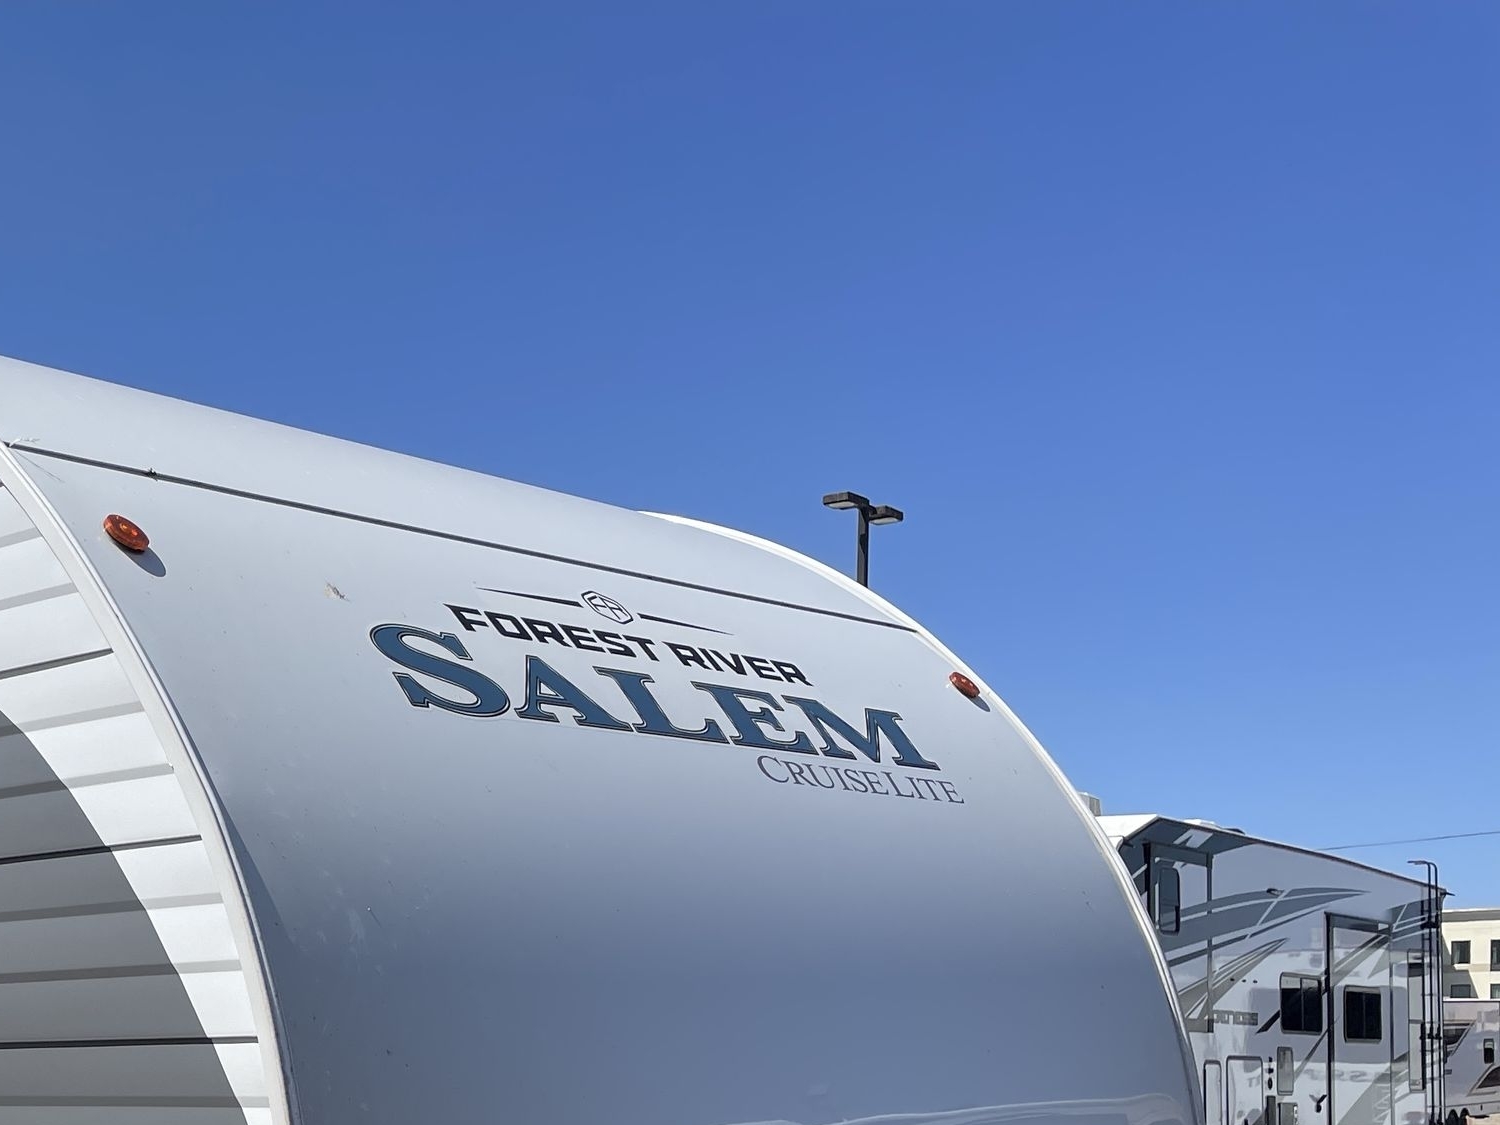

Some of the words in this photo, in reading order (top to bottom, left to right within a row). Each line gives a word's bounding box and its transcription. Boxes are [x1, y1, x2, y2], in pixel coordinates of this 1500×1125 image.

[370, 624, 941, 771] SALEM
[444, 603, 660, 662] FOREST
[662, 641, 813, 686] RIVER
